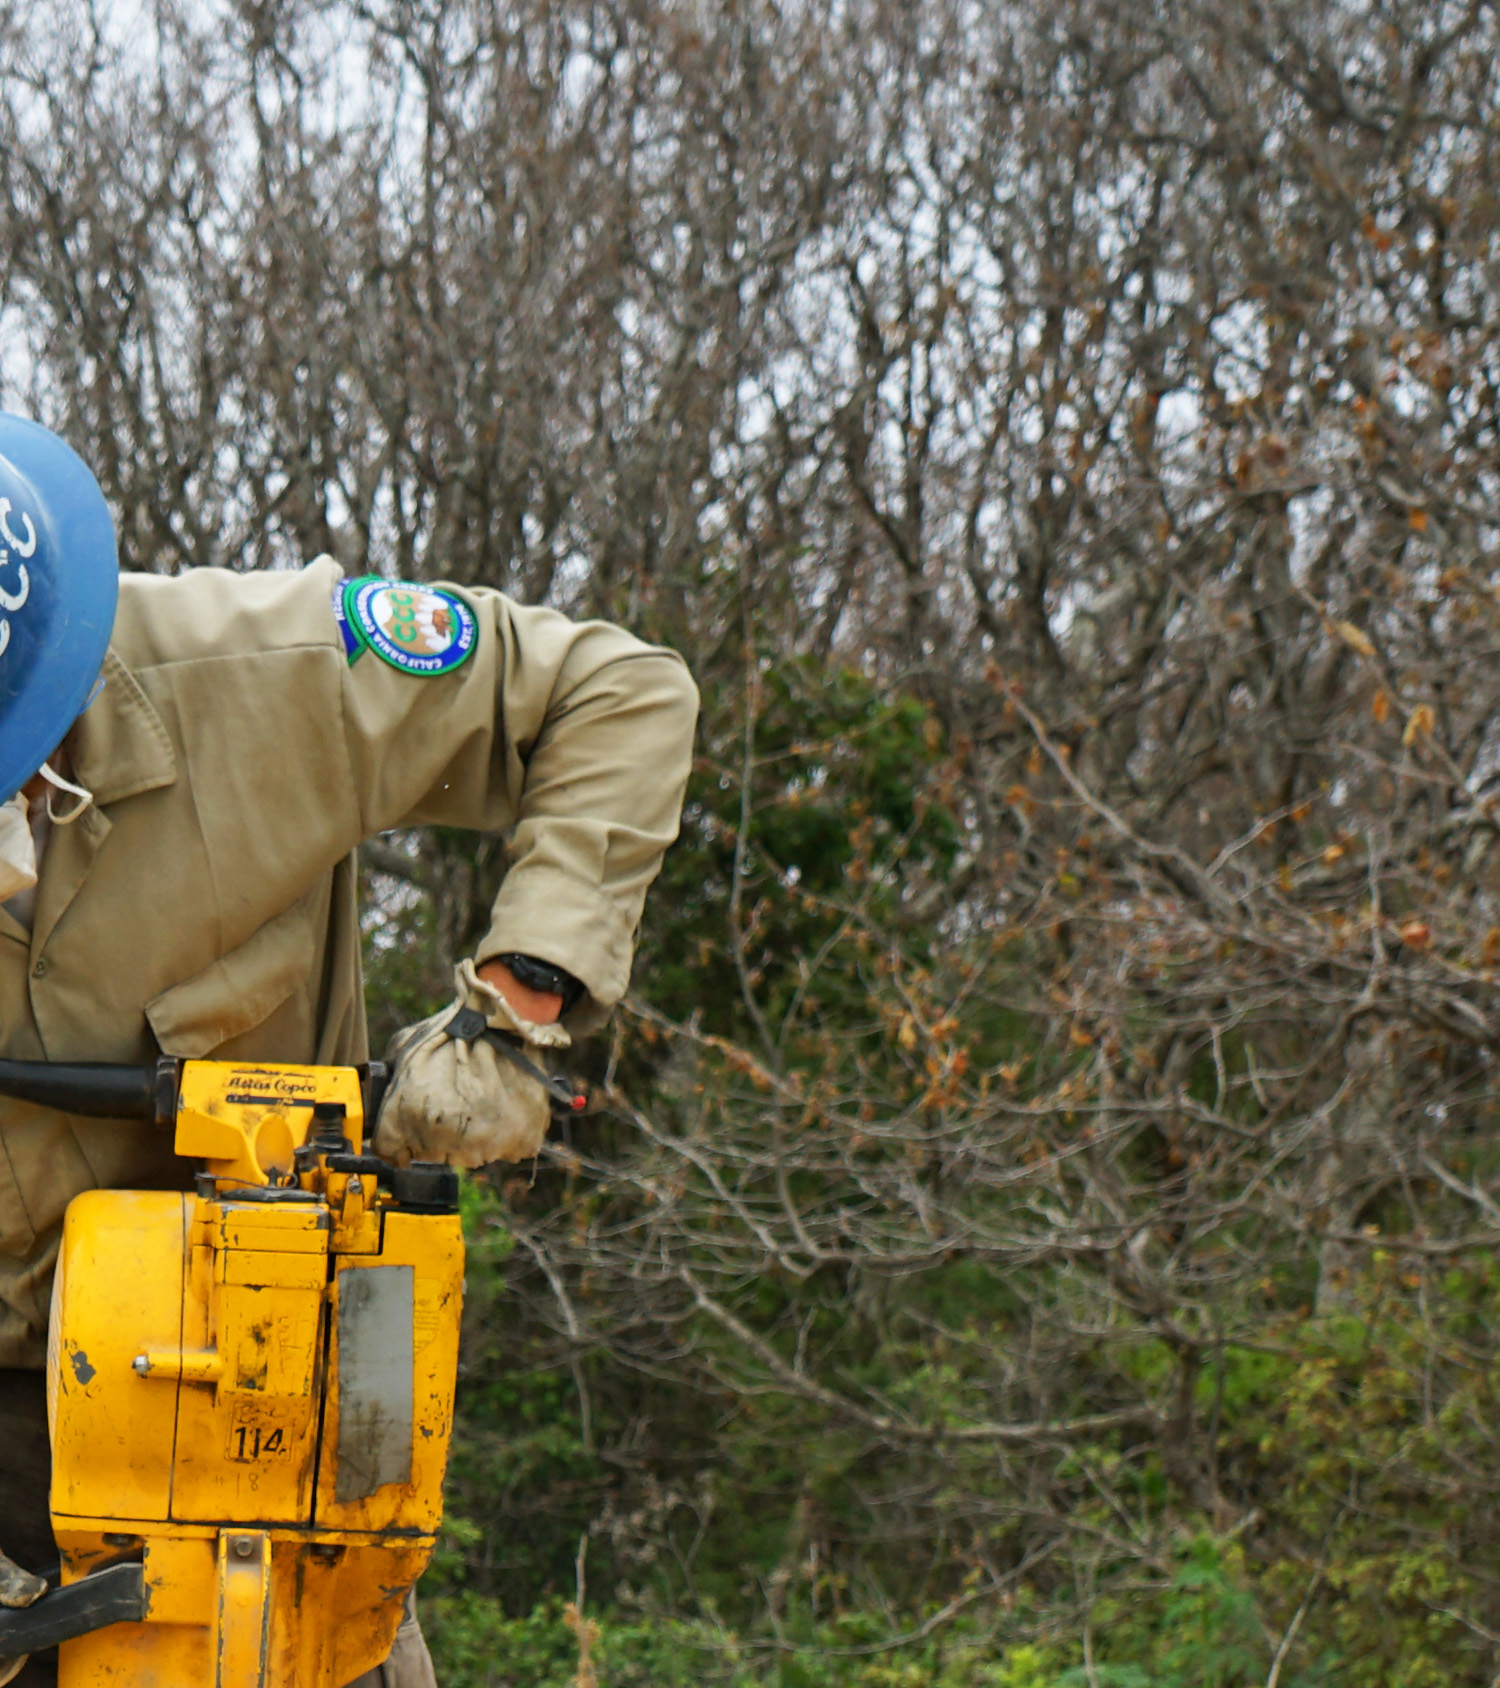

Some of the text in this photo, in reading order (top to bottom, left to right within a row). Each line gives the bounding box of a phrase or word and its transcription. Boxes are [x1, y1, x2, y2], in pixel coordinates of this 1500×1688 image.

[390, 592, 417, 643] CCC
[373, 632, 443, 671] CALIFORNIA
[274, 1079, 317, 1095] Copco
[234, 1425, 286, 1459] 114
